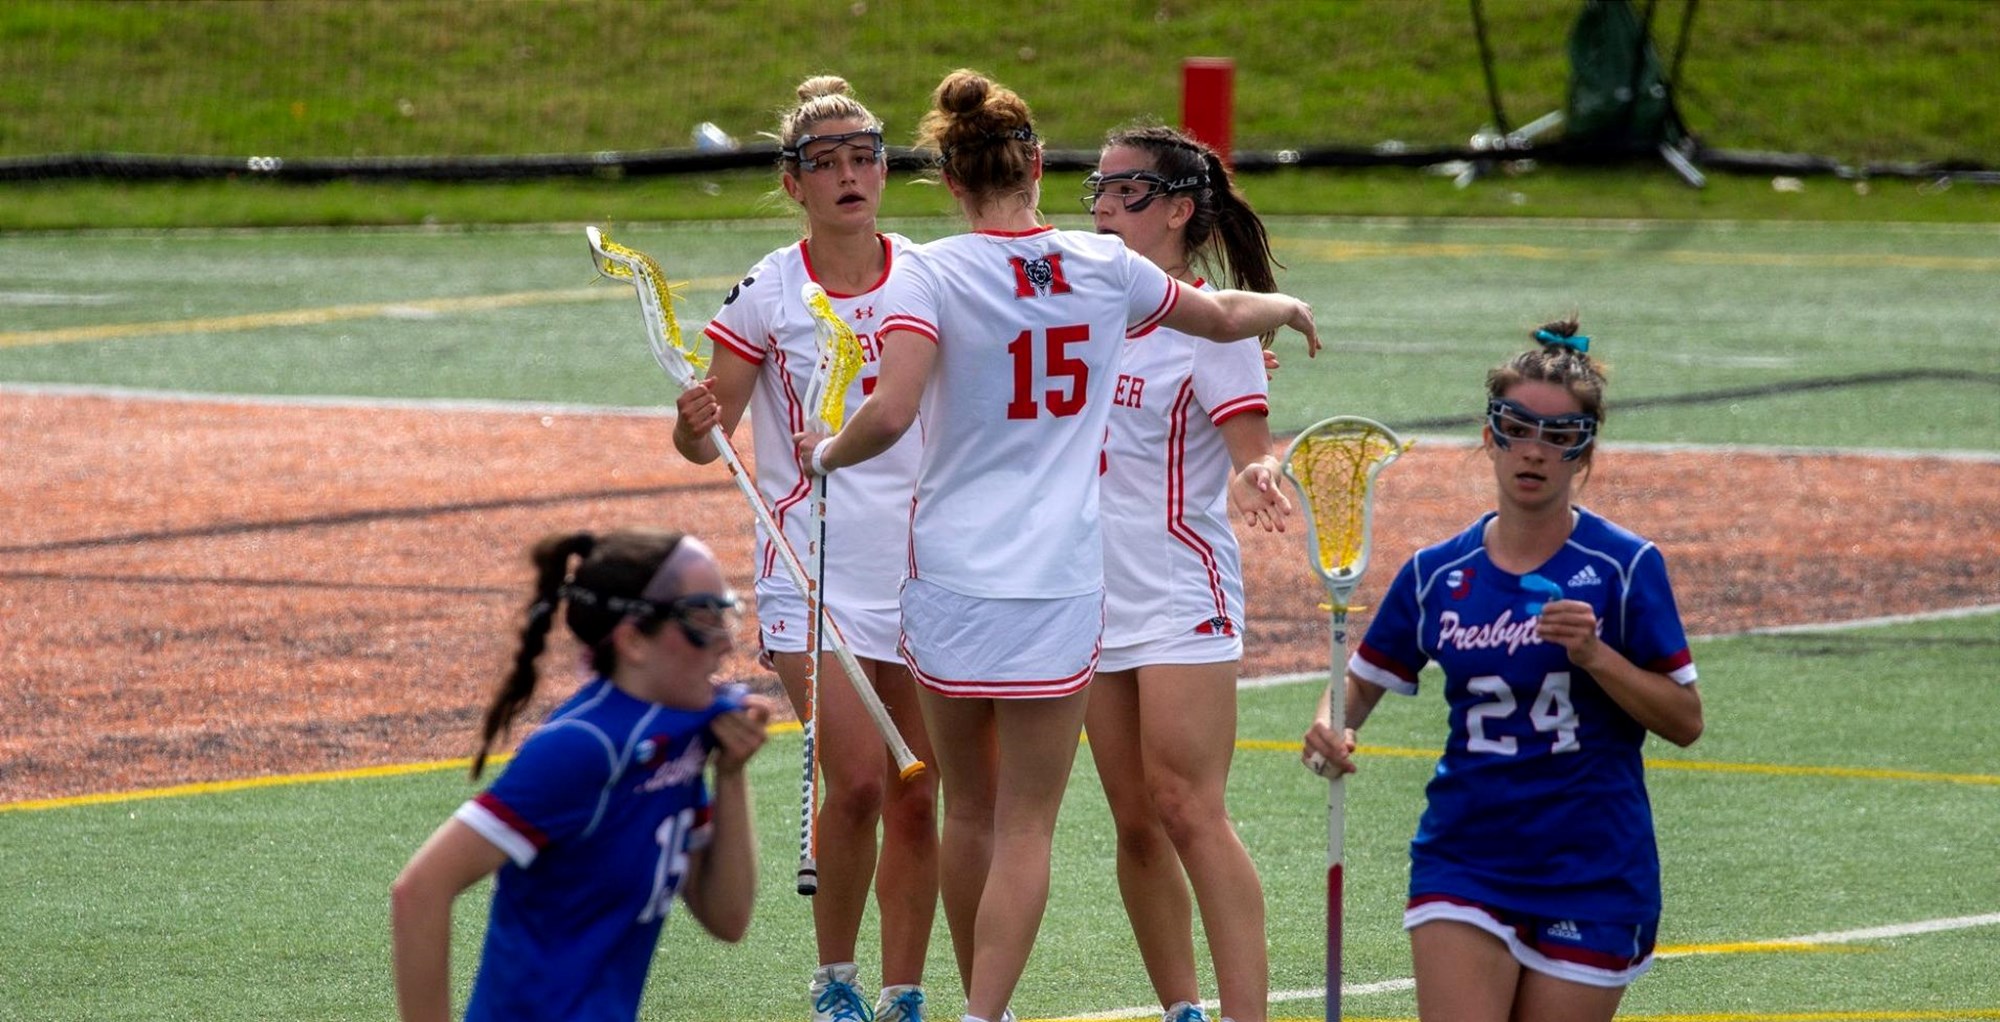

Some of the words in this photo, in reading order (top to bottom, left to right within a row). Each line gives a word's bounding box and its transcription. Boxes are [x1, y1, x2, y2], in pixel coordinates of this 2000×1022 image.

[1167, 176, 1198, 191] STX
[1007, 323, 1090, 420] 15
[1437, 609, 1603, 656] Presbyt
[1466, 671, 1581, 756] 24
[1547, 927, 1582, 941] adidas
